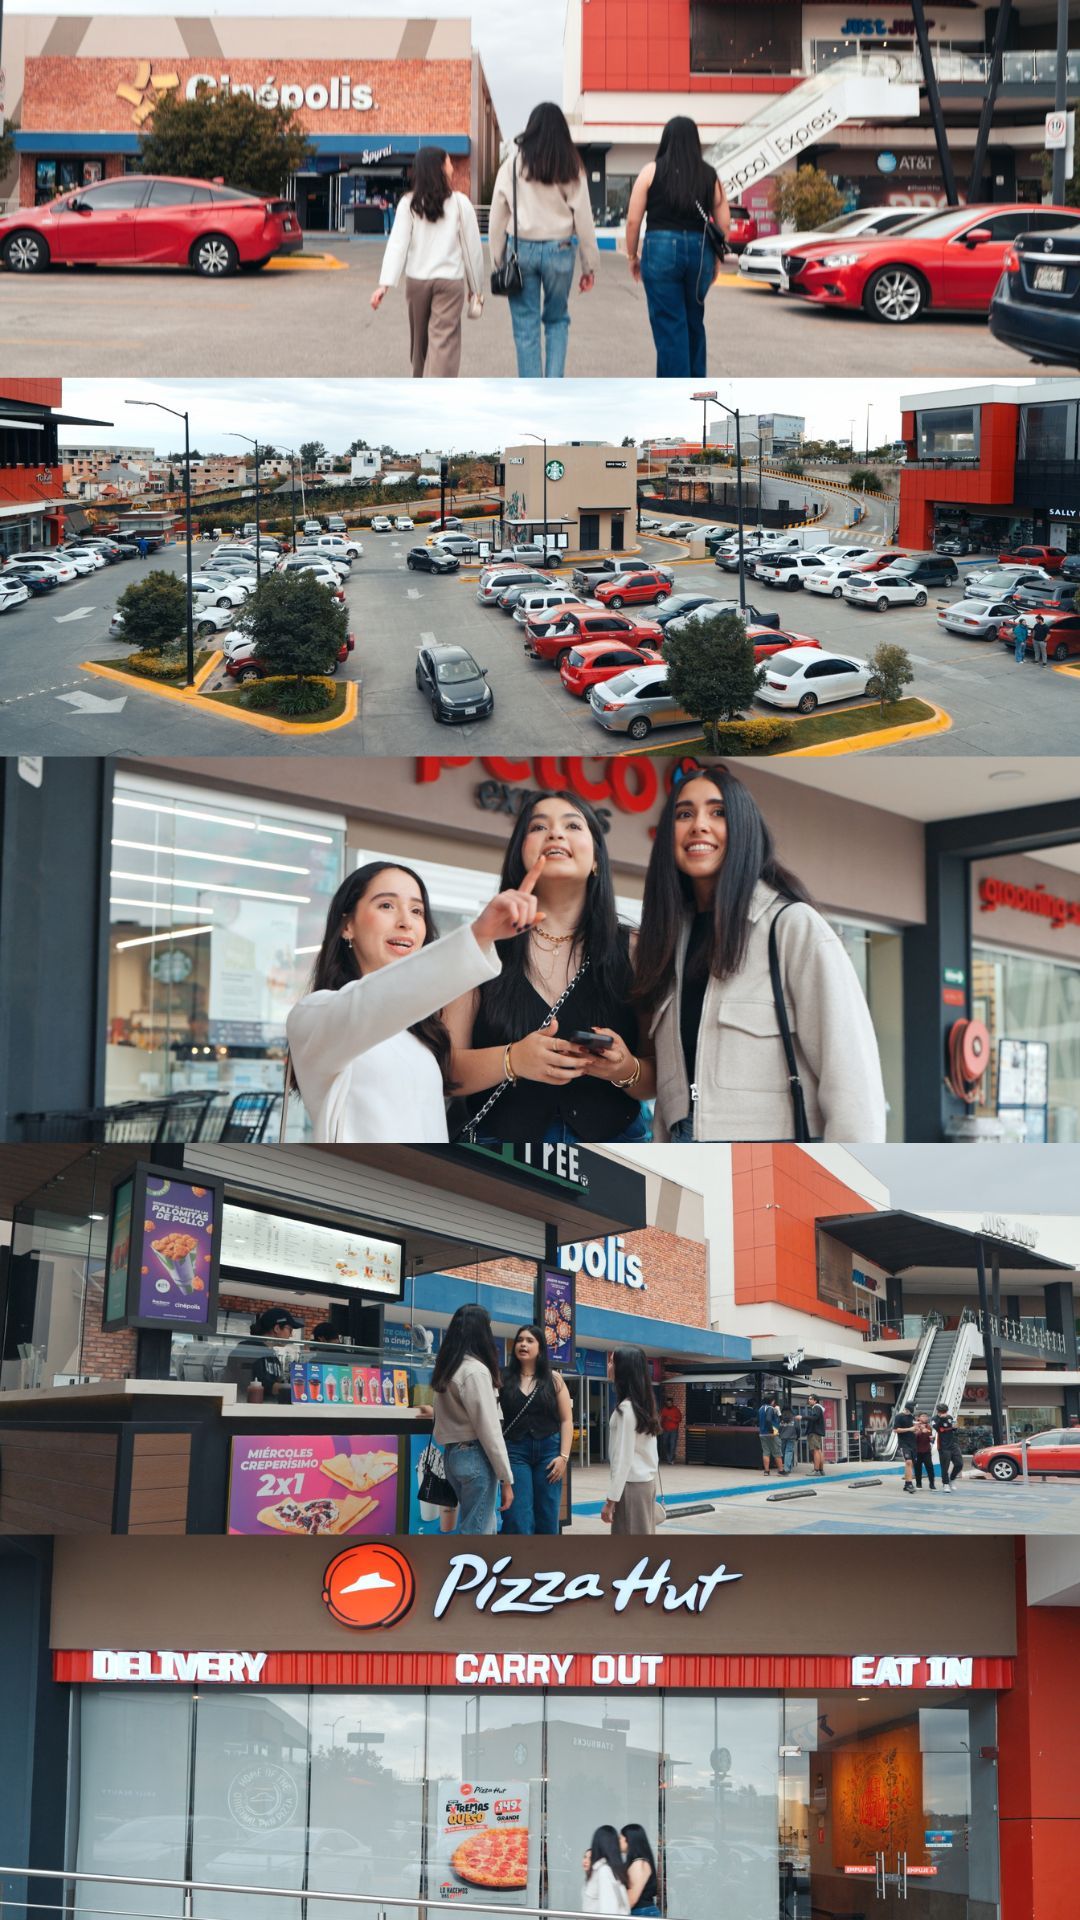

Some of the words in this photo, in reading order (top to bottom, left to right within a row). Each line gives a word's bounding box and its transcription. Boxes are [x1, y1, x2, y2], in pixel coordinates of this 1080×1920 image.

[361, 144, 393, 165] Spyral
[724, 152, 770, 193] erpool
[775, 106, 838, 155] Express
[899, 155, 934, 170] AT&T
[1049, 508, 1077, 517] SALLY
[978, 876, 1066, 929] grooming
[152, 1204, 209, 1221] PALOMITAS
[155, 1212, 171, 1221] DE
[171, 1215, 205, 1227] POLLO
[557, 1236, 648, 1290] polis.
[174, 1302, 201, 1310] cinépolis
[247, 1446, 313, 1459] MIÉRCOLES
[240, 1458, 318, 1471] CREPERÍSIMO
[256, 1473, 305, 1497] 2x1
[433, 1553, 605, 1619] Pizza
[612, 1556, 744, 1613] Hut
[92, 1650, 268, 1682] DELIVERY
[455, 1653, 574, 1684] CARRY
[592, 1654, 664, 1685] OUT
[852, 1656, 920, 1686] EAT
[926, 1656, 973, 1687] IN
[474, 1786, 492, 1794] Pizza
[445, 1803, 489, 1814] EXTREMAS
[447, 1812, 485, 1826] QUESO
